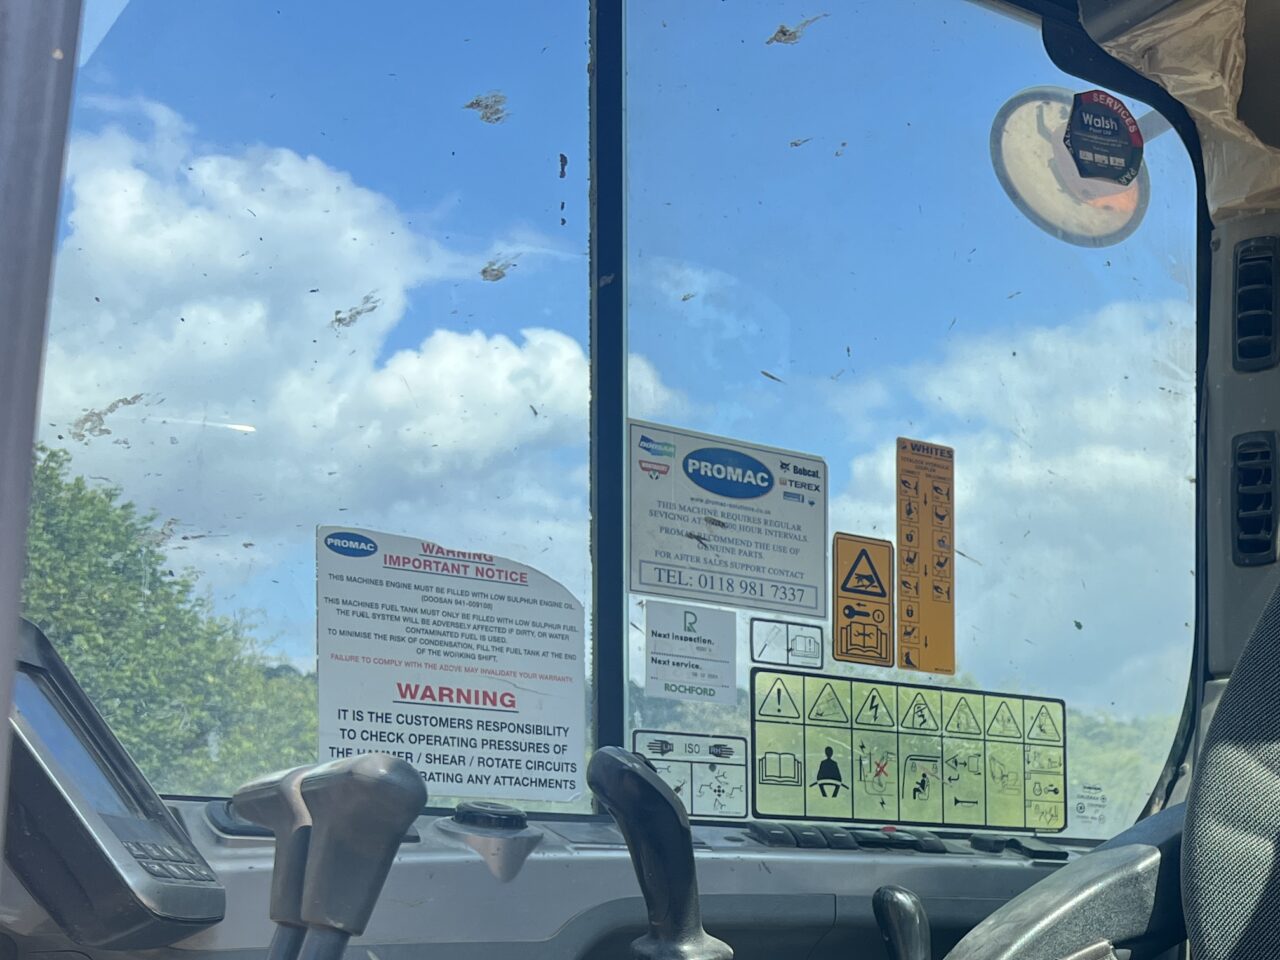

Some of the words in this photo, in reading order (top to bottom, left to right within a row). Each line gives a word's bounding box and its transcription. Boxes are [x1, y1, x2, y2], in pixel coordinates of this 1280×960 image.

[1082, 112, 1118, 131] Walsh
[1093, 93, 1137, 133] SERVICES
[1120, 168, 1137, 185] PAR
[911, 444, 954, 459] WHITES
[688, 459, 769, 487] PROMAC
[788, 480, 821, 493] TEREX
[649, 510, 689, 523] SEVICING
[739, 523, 762, 534] HOUR
[658, 500, 676, 510] THIS
[679, 504, 718, 518] MACHINE
[720, 511, 762, 524] REQUIRES
[764, 519, 802, 532] REGULAR
[328, 538, 375, 552] PROMAC
[754, 541, 770, 551] THE
[772, 544, 788, 554] USE
[789, 548, 801, 556] OF
[384, 554, 470, 576] IMPORTANT
[475, 566, 528, 584] NOTICE
[655, 550, 672, 559] FOR
[674, 552, 700, 564] AFTER
[703, 558, 728, 568] SALES
[730, 561, 766, 574] SUPPORT
[768, 567, 805, 580] CONTACT
[328, 573, 345, 582] THIS
[346, 576, 384, 586] MACHINES
[386, 580, 412, 590] ENGINE
[414, 584, 434, 593] MUST
[446, 588, 470, 597] FILLED
[472, 591, 489, 600] WITH
[490, 594, 506, 602] LOW
[506, 596, 538, 606] SULPHUR
[540, 600, 562, 609] ENGINE
[654, 567, 694, 588] TEL:
[698, 574, 735, 593] 0118
[740, 580, 764, 598] 981
[770, 584, 805, 602] 7337
[324, 596, 340, 606] THIS
[342, 599, 380, 610] MACHINES
[382, 604, 399, 612] FUEL
[400, 606, 418, 614] TANK
[420, 608, 440, 616] MUST
[442, 610, 460, 619] ONLY
[472, 614, 496, 623] FILLED
[496, 617, 514, 625] WITH
[514, 619, 530, 627] LOW
[532, 621, 561, 630] SULPHUR
[336, 608, 350, 617] THE
[352, 610, 370, 619] FUEL
[372, 613, 400, 622] SYSTEM
[402, 616, 420, 624] WILL
[432, 620, 472, 630] ADVERSELY
[472, 624, 506, 634] AFFECTED
[548, 633, 570, 641] WATER
[328, 628, 338, 636] TO
[338, 630, 372, 640] MINIMISE
[374, 632, 388, 642] THE
[390, 635, 406, 643] RISK
[476, 644, 490, 652] FILL
[490, 645, 504, 654] THE
[506, 647, 522, 656] FUEL
[524, 650, 540, 658] TANK
[405, 626, 460, 639] CONTAMINATED
[460, 632, 478, 641] FUEL
[651, 630, 670, 639] Next
[330, 652, 360, 662] FAILURE
[372, 658, 403, 667] COMPLY
[404, 661, 424, 669] WITH
[424, 662, 438, 670] THE
[480, 668, 518, 678] INVALIDATE
[518, 671, 538, 680] YOUR
[428, 648, 441, 657] THE
[442, 650, 476, 660] WORKING
[651, 656, 670, 666] Next
[396, 682, 516, 709] WARNING
[664, 682, 716, 697] ROCHFORD
[338, 708, 348, 721] IT
[352, 710, 364, 722] IS
[368, 711, 392, 724] THE
[396, 714, 473, 730] CUSTOMERS
[476, 720, 570, 737] RESPONSIBILITY
[340, 728, 356, 740] TO
[360, 730, 404, 744] CHECK
[408, 734, 478, 749] OPERATING
[481, 738, 550, 754] PRESSURES
[553, 744, 568, 755] OF
[684, 744, 700, 754] ISO
[329, 746, 352, 758] THE
[417, 752, 422, 763] /
[425, 752, 466, 766] SHEAR
[469, 756, 474, 767] /
[478, 756, 522, 770] ROTATE
[525, 760, 577, 773] CIRCUITS
[420, 771, 463, 784] RATING
[466, 774, 492, 785] ANY
[494, 776, 576, 790] ATTACHMENTS
